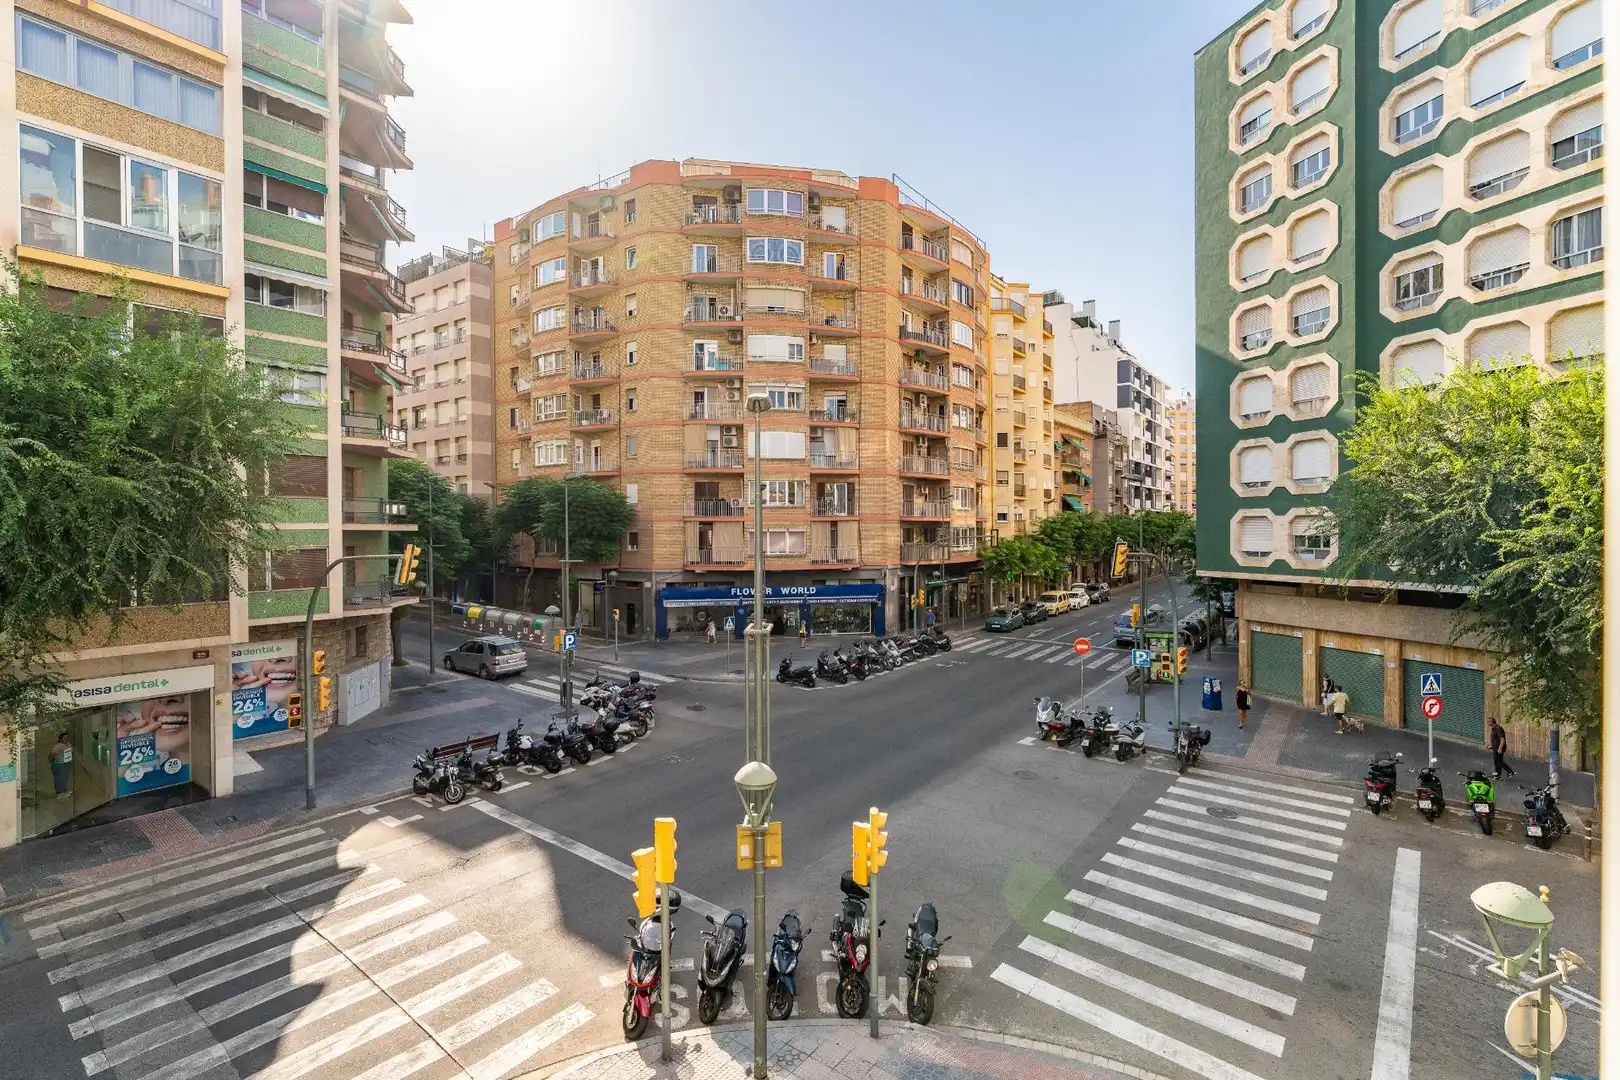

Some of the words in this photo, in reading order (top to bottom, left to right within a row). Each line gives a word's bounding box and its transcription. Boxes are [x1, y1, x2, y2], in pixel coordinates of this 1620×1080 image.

[781, 586, 817, 595] WORLD
[233, 698, 264, 714] 26%
[120, 746, 154, 766] 26%
[168, 759, 179, 767] 26
